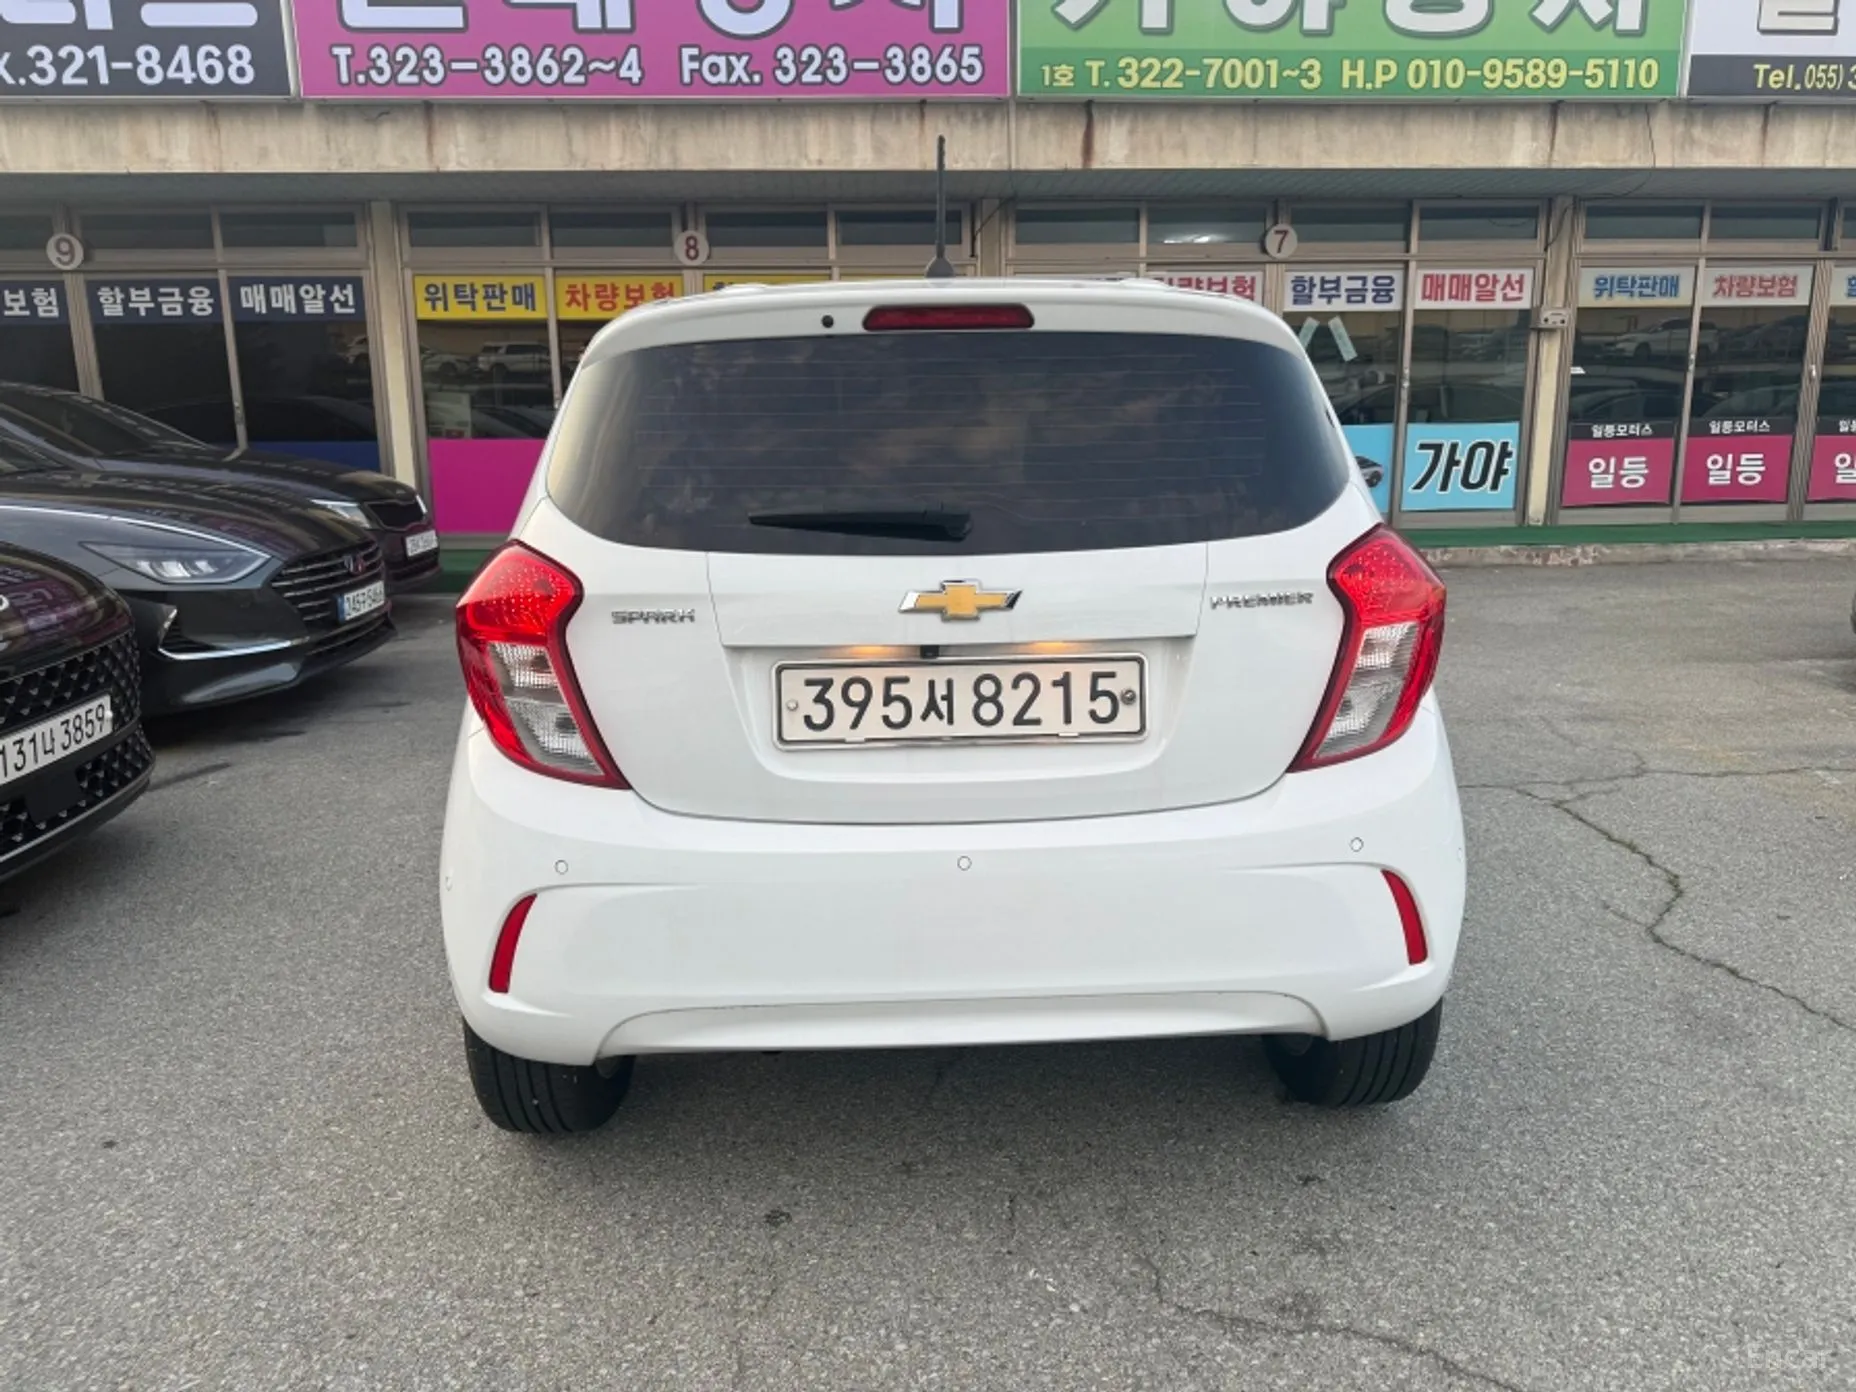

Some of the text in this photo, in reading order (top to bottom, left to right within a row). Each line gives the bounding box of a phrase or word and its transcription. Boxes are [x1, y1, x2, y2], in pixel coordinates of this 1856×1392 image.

[680, 46, 761, 84] Fax.
[774, 46, 983, 84] 323-3865
[1041, 64, 1075, 87] 1호
[1341, 59, 1398, 89] H.P
[1407, 58, 1660, 89] 010-9589-5110
[53, 239, 76, 266] 9
[685, 236, 700, 261] 8
[1272, 229, 1290, 254] 7
[97, 285, 215, 317] 할부금융
[240, 283, 357, 315] 매매알선
[424, 282, 537, 312] 위탁판매
[1290, 275, 1396, 304] 할부금융
[1421, 273, 1525, 303] 매매알선
[1594, 275, 1680, 298] 위탁판매
[1713, 275, 1798, 298] 차량보험
[4, 287, 60, 318] 보험
[1410, 439, 1514, 493] 가야
[1588, 456, 1649, 489] 일등
[1706, 453, 1766, 485] 일등
[1210, 591, 1314, 610] PREMIER
[611, 607, 696, 625] SPARK
